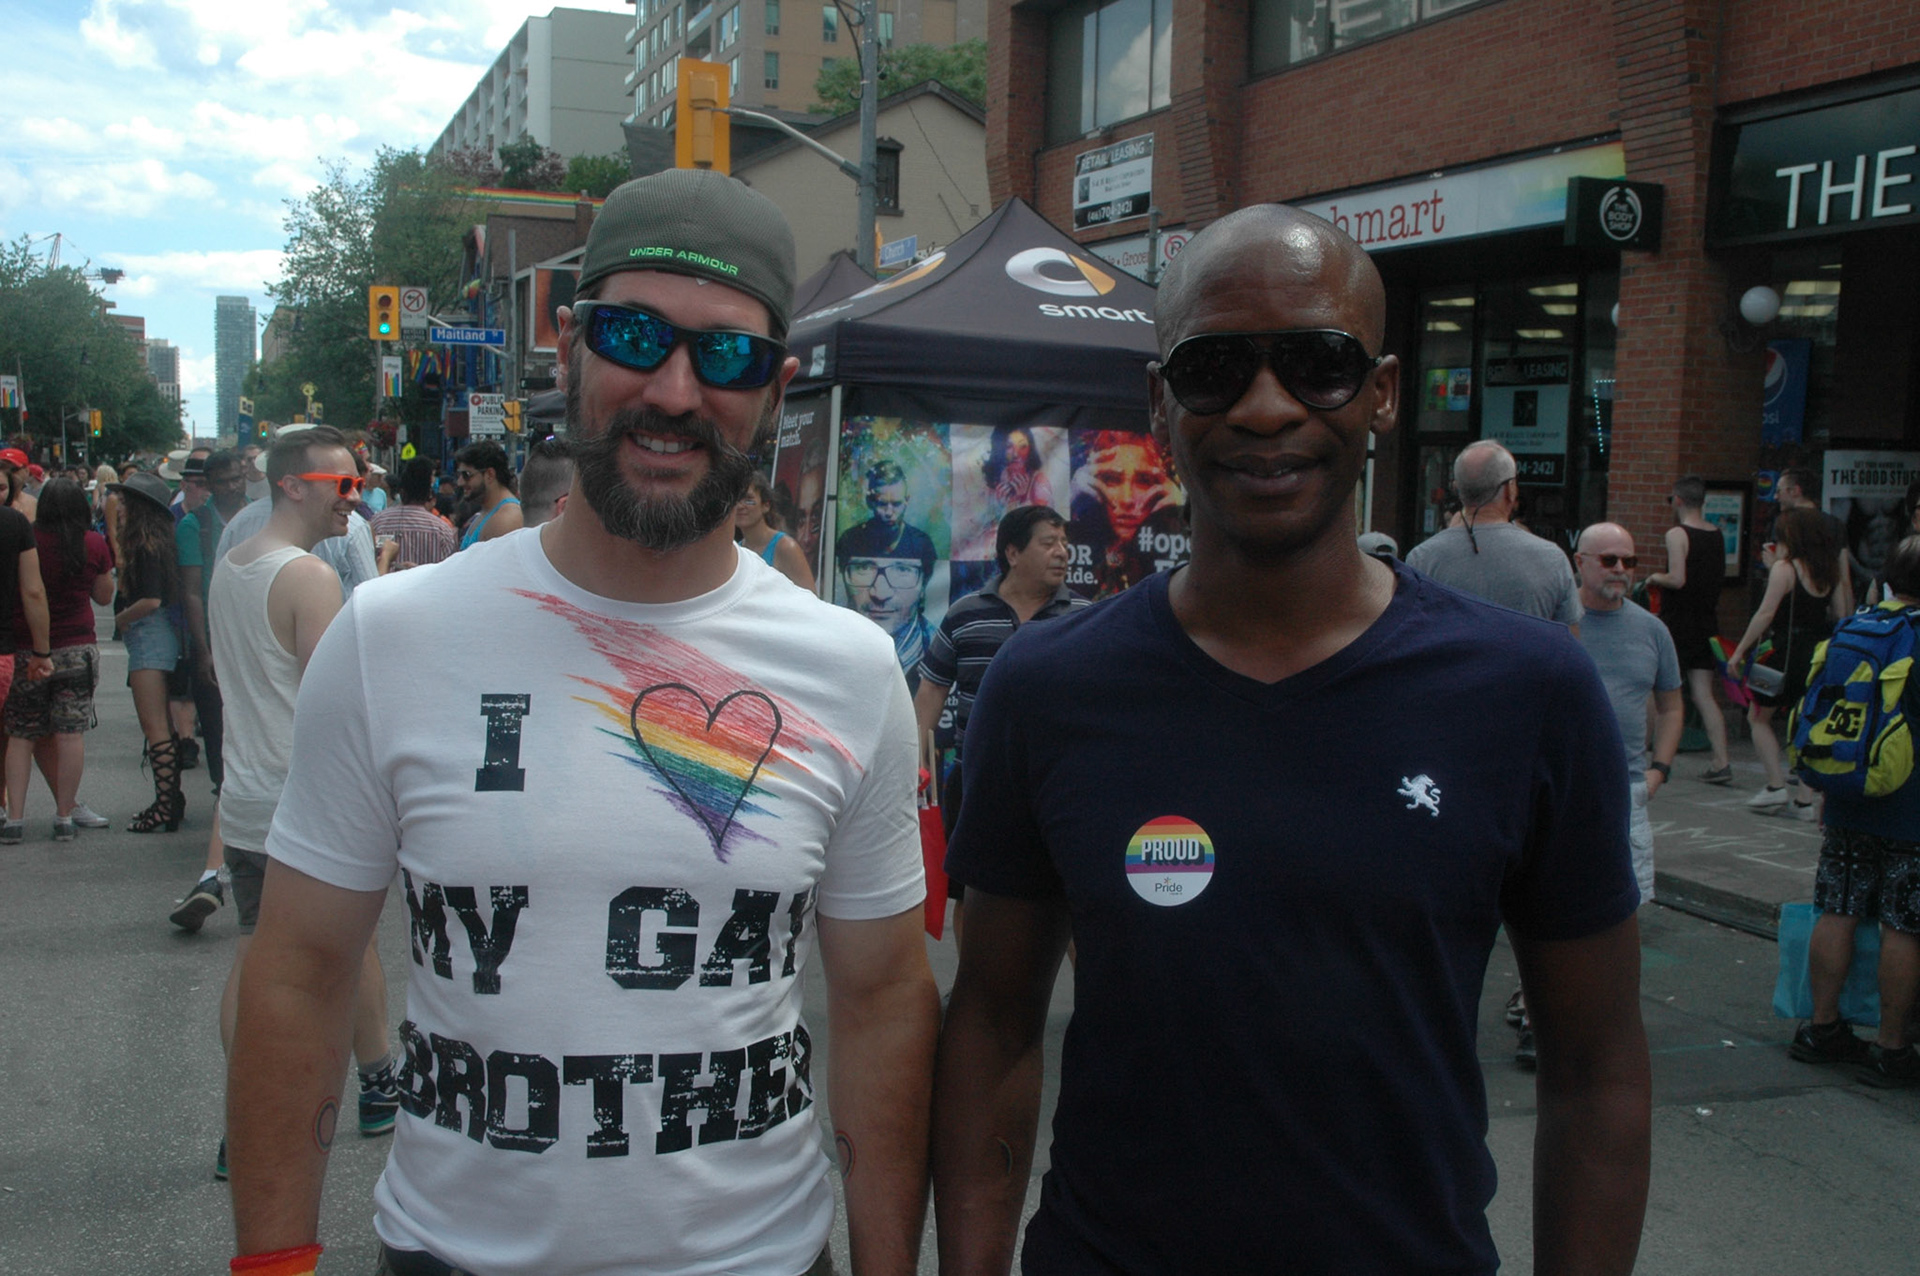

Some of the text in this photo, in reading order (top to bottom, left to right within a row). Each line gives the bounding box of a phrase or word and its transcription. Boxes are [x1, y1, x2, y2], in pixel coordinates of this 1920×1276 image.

[1111, 141, 1146, 164] LEASING
[1775, 145, 1918, 229] THE
[1328, 188, 1445, 245] hmart
[1608, 210, 1635, 222] BODY
[1614, 202, 1629, 213] THE
[1608, 220, 1633, 231] SHOP
[629, 247, 739, 276] UNDER ARMOUR
[1038, 303, 1154, 325] smart
[436, 328, 486, 341] Maitland
[1523, 361, 1567, 379] LEASING
[782, 411, 815, 430] Meet your
[1516, 461, 1554, 476] 04-2421
[1831, 469, 1920, 486] THE GOOD STUF
[1066, 544, 1093, 566] OR
[1066, 566, 1099, 585] ide.
[474, 693, 531, 792] I
[1141, 838, 1202, 863] PROUD
[1154, 882, 1183, 893] Pride
[400, 866, 530, 995] MY
[398, 1018, 815, 1158] BROTHER
